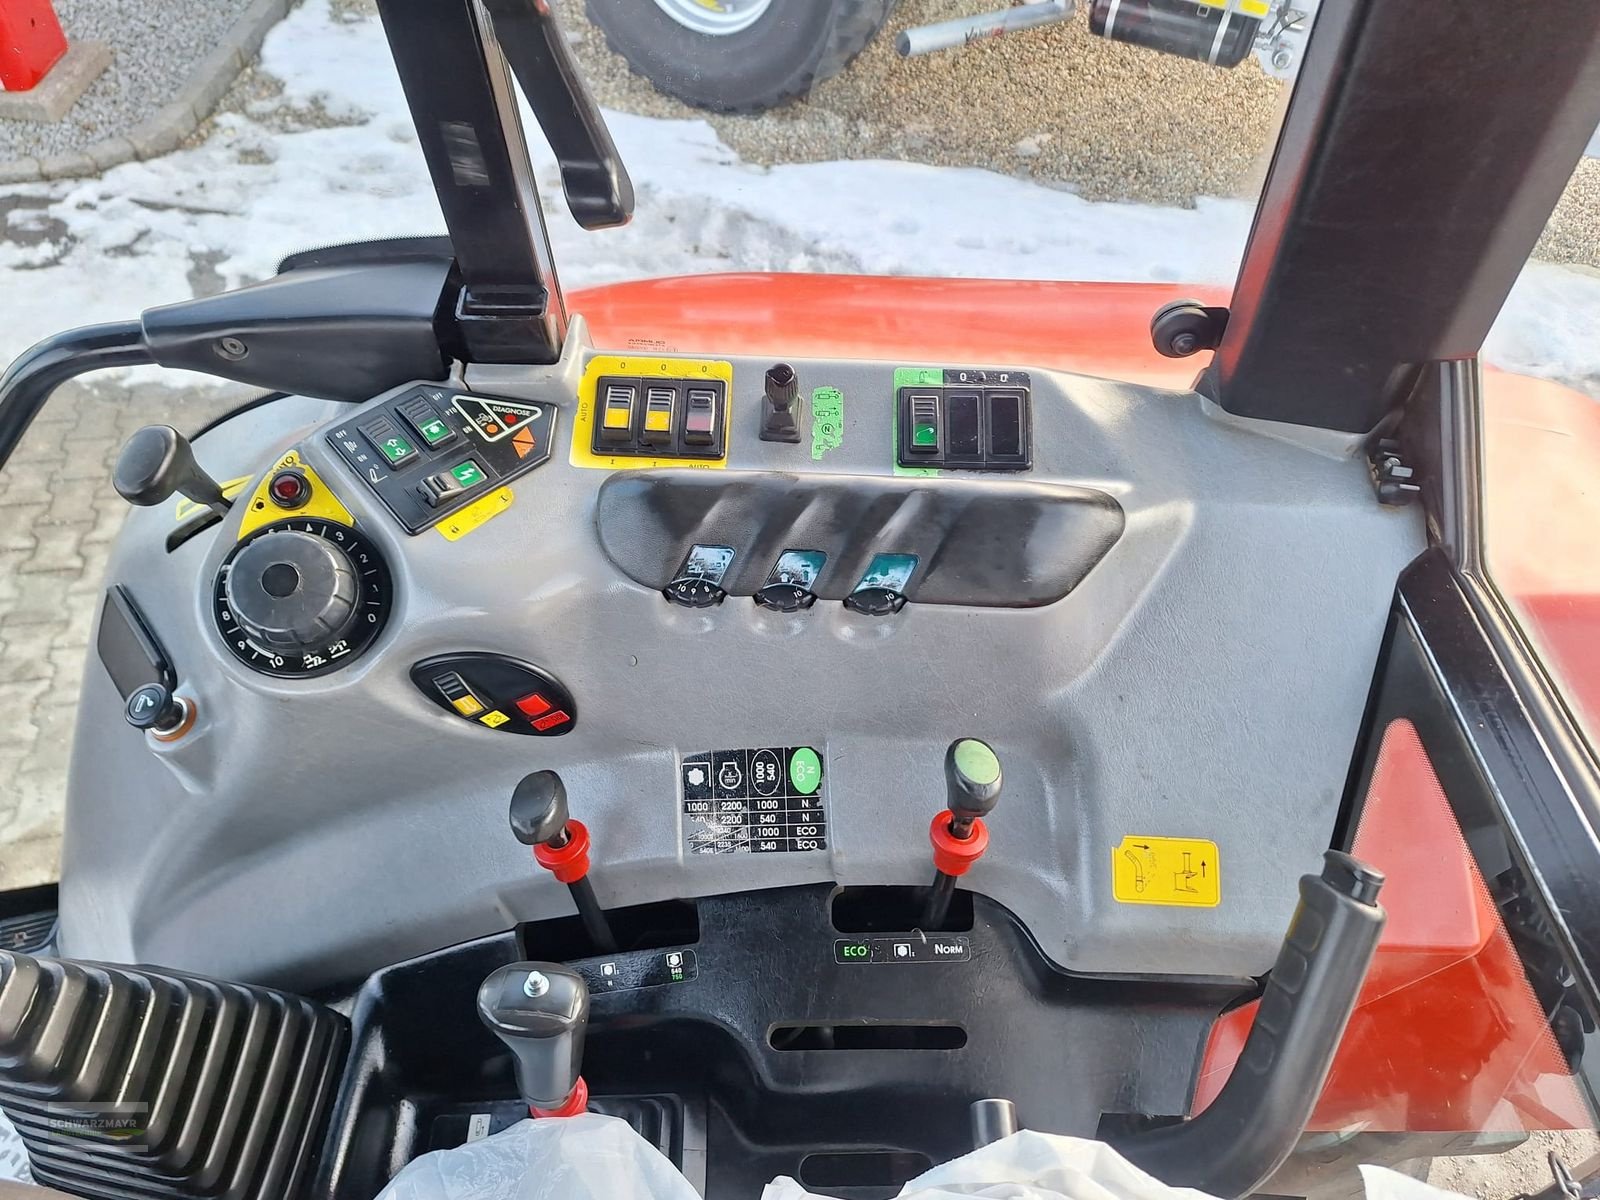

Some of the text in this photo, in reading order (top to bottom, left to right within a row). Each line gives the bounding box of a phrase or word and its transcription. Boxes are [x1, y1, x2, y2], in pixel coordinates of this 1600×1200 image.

[492, 406, 531, 416] DIAGNOSE
[336, 532, 344, 541] 3
[360, 554, 368, 563] 2
[678, 584, 686, 592] 10
[885, 592, 894, 601] 10
[222, 610, 230, 620] 8
[368, 613, 376, 622] 0
[238, 640, 246, 650] 9
[269, 656, 284, 668] 10
[756, 762, 764, 783] 1000
[767, 764, 776, 780] 540
[796, 760, 805, 782] ECO
[687, 800, 809, 812] 1000 2200 1000 N
[721, 816, 742, 824] 2200
[760, 814, 776, 824] 540
[802, 813, 810, 822] N
[758, 828, 780, 836] 1000
[796, 826, 817, 836] ECO
[760, 841, 776, 850] 540
[797, 840, 818, 849] ECO
[844, 946, 866, 956] ECO
